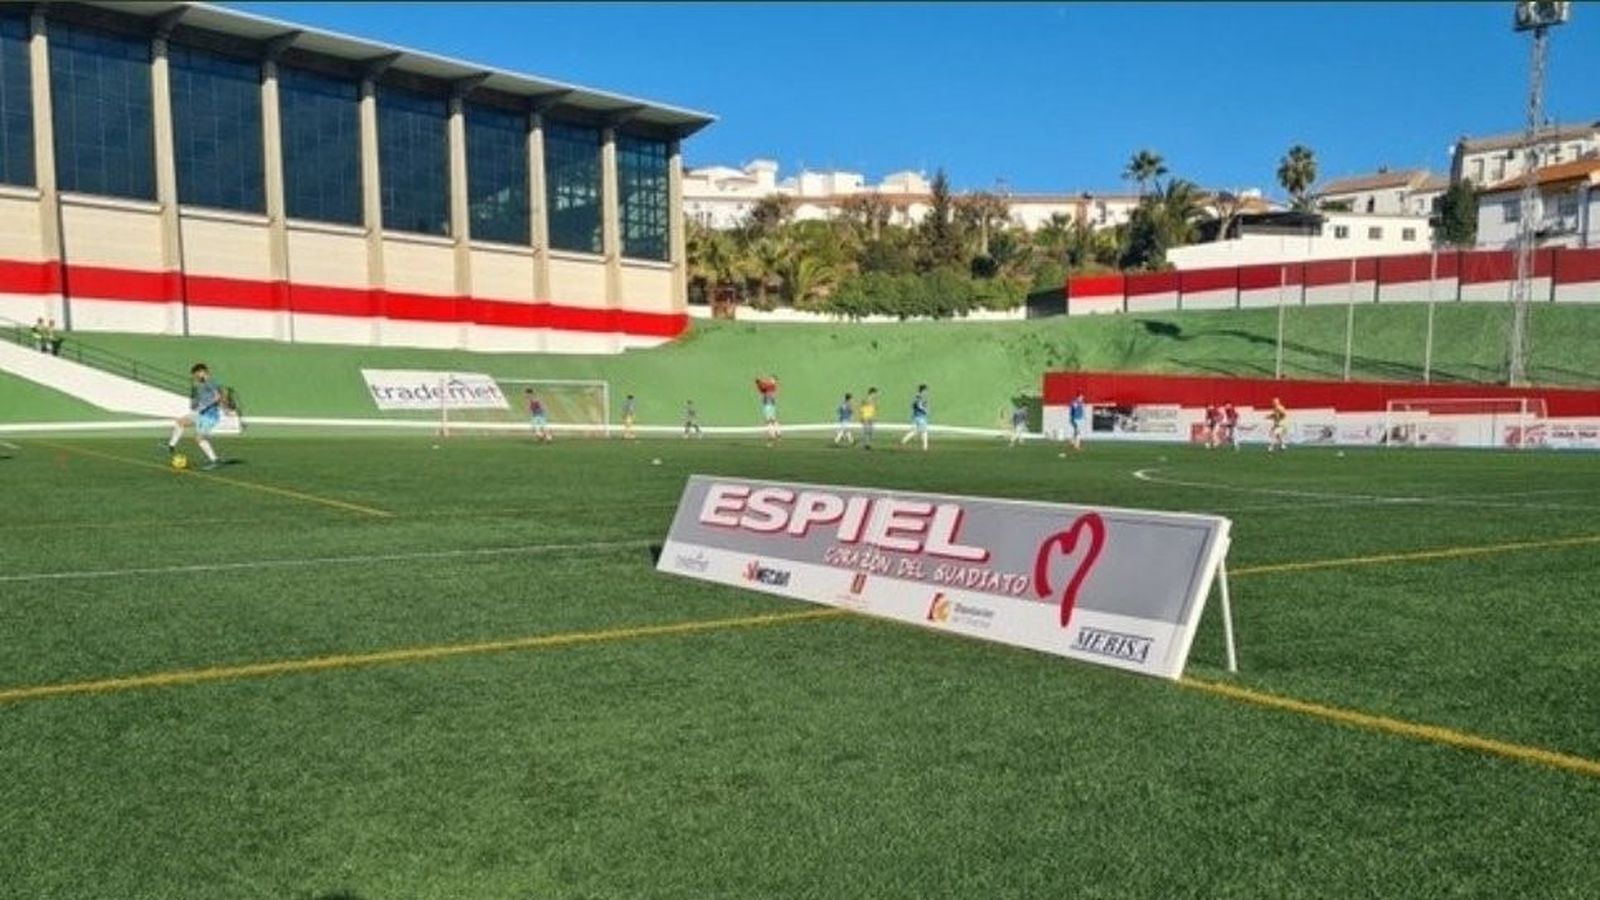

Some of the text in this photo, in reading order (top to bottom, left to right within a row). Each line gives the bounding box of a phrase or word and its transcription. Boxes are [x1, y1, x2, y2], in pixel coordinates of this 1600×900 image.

[372, 382, 497, 402] trademet
[700, 483, 989, 562] ESPIEL
[899, 558, 927, 579] DEL
[933, 565, 1028, 594] GUADIATO
[1076, 630, 1152, 660] MEBISA
